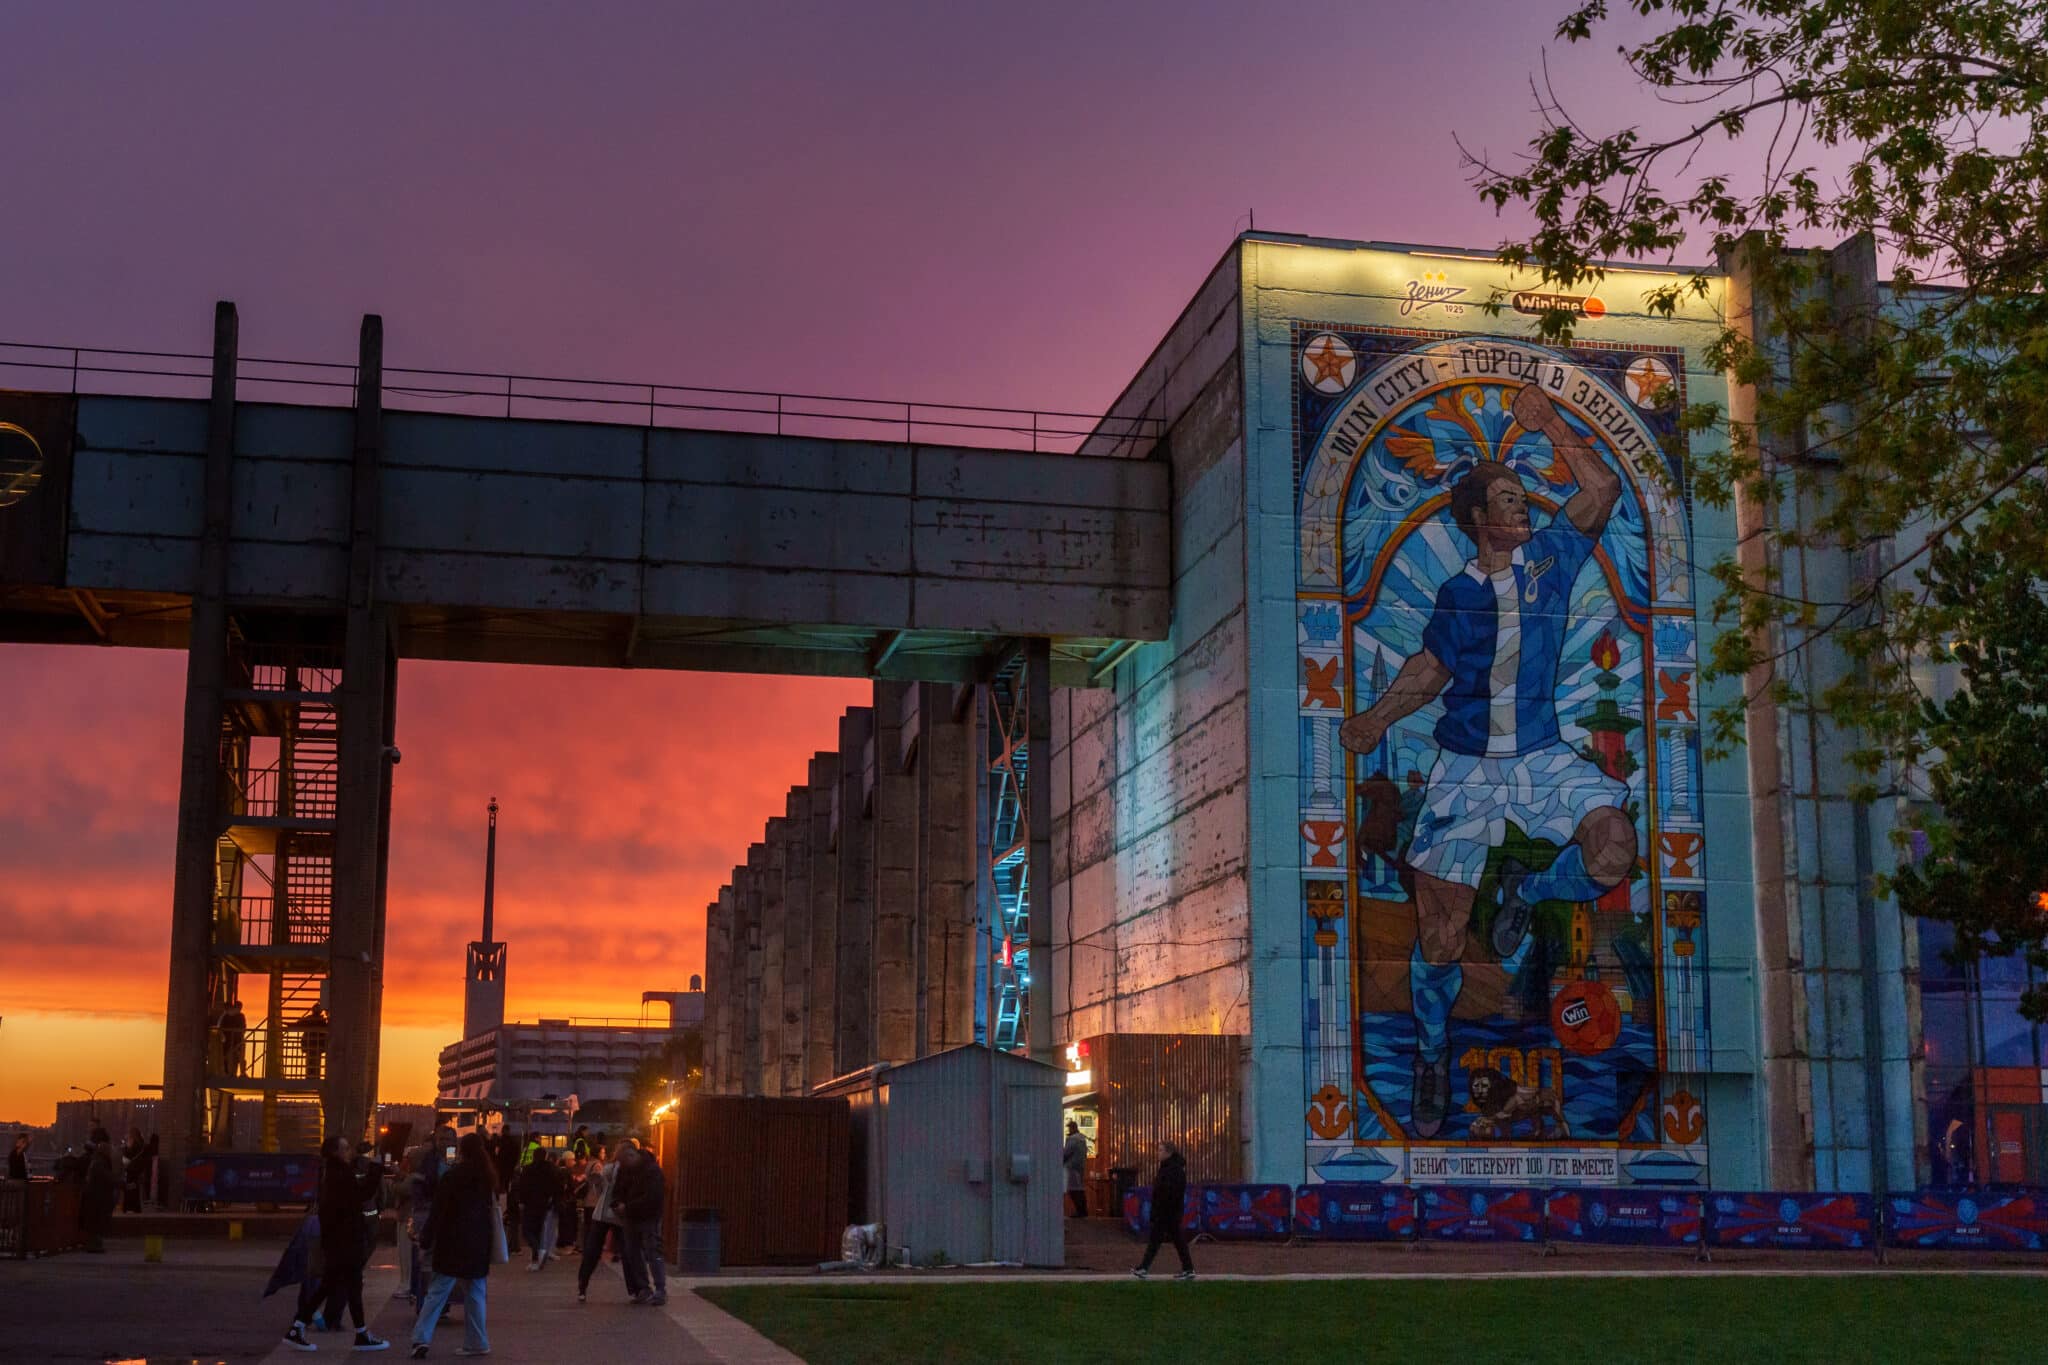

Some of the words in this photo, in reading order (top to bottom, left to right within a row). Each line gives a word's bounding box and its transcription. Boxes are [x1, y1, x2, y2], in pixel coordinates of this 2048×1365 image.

[1445, 304, 1465, 314] 1925
[1518, 294, 1580, 312] Winline
[1330, 401, 1379, 457] WIN
[1374, 358, 1430, 407] CITY
[1461, 348, 1540, 385] ГОРОД
[1548, 366, 1565, 390] В
[1563, 1006, 1589, 1024] Win
[1413, 1157, 1448, 1175] ЗЕНИТ
[1460, 1157, 1523, 1175] ПЕТЕРБУРГ
[1526, 1157, 1543, 1174] 100
[1571, 1158, 1615, 1176] ВМЕСТЕ
